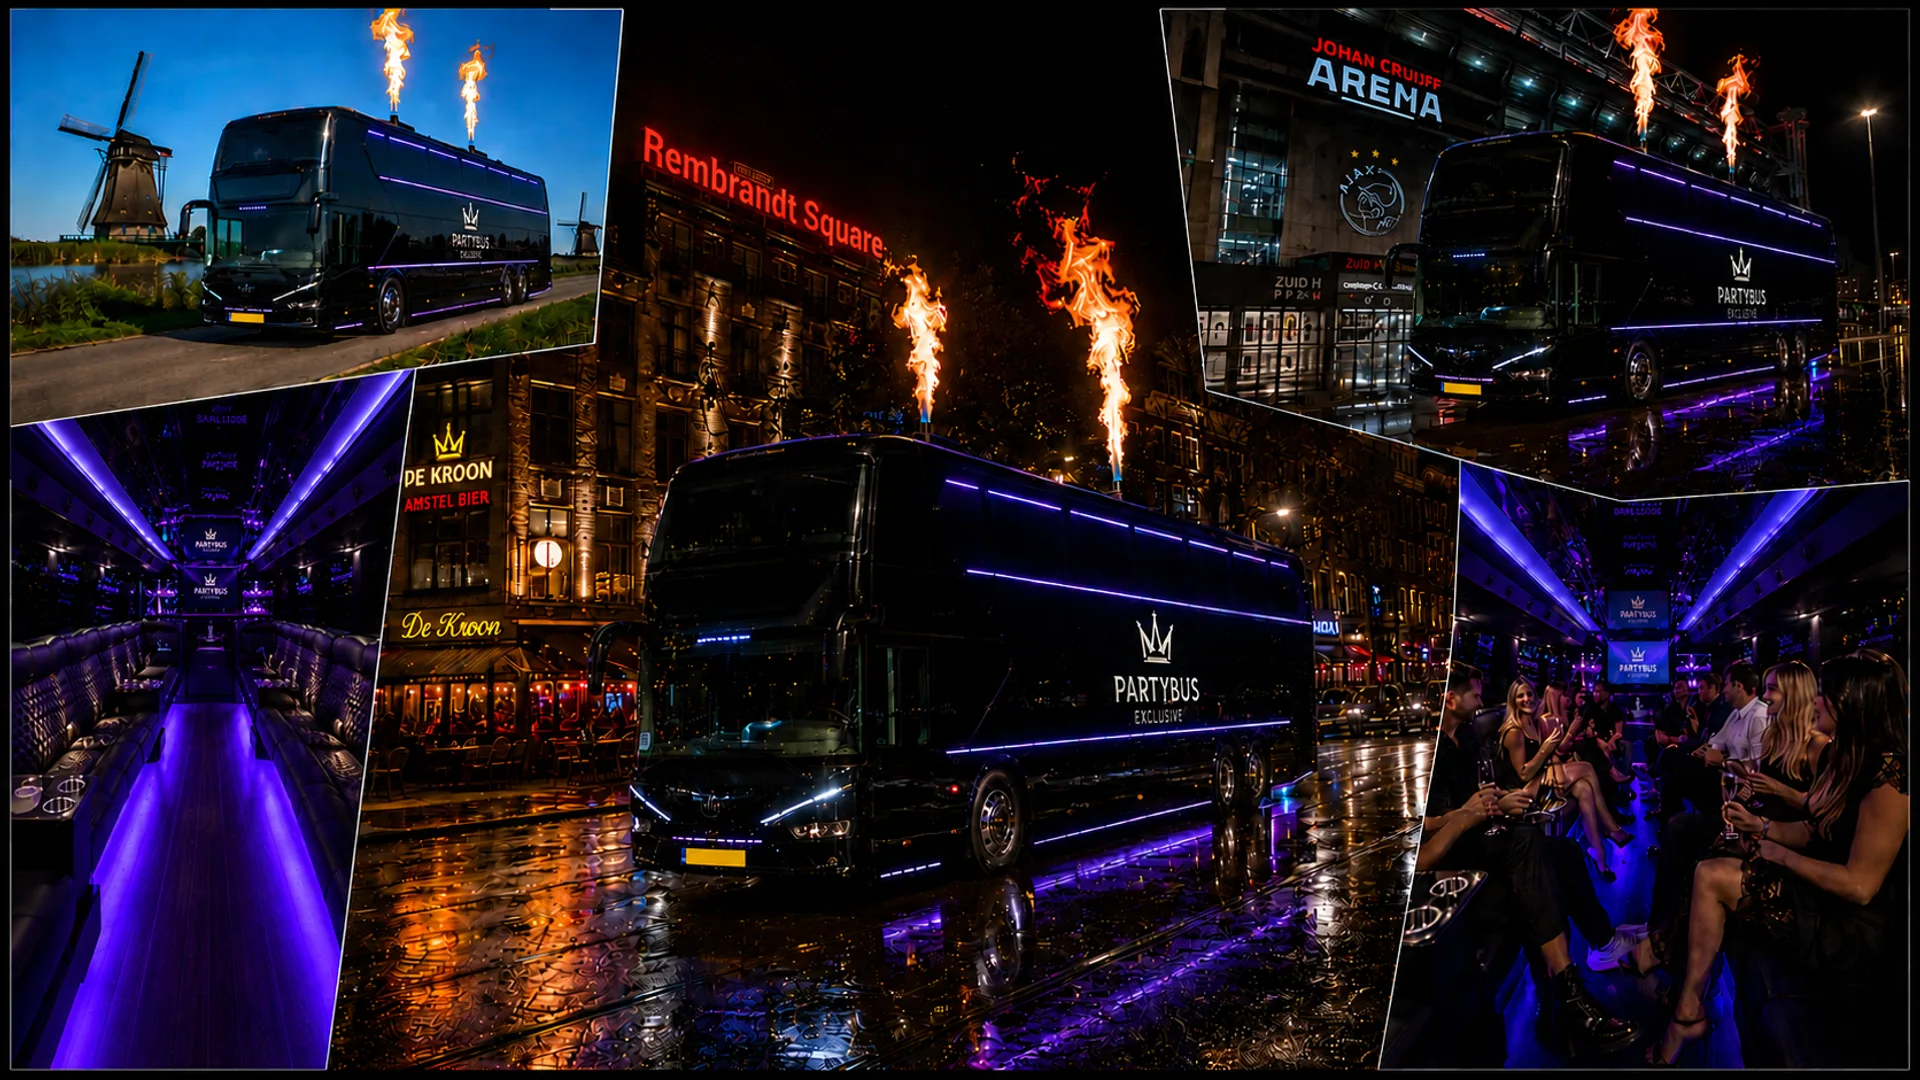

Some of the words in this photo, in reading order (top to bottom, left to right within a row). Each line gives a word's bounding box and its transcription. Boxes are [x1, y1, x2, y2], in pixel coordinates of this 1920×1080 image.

[1312, 37, 1375, 69] JOHAN
[1380, 59, 1442, 90] CRUIJFF
[643, 126, 797, 225] Rembrandt
[804, 200, 883, 259] Square
[1275, 276, 1308, 289] ZUID
[1717, 285, 1767, 305] PARTYBUS
[430, 460, 493, 485] KROON
[404, 493, 455, 513] AMSTEL
[458, 490, 490, 507] BIER
[401, 610, 432, 639] De
[436, 611, 502, 638] Kroon
[1113, 675, 1200, 704] PARTYBUS
[1134, 708, 1183, 725] EXCLUSIVE
